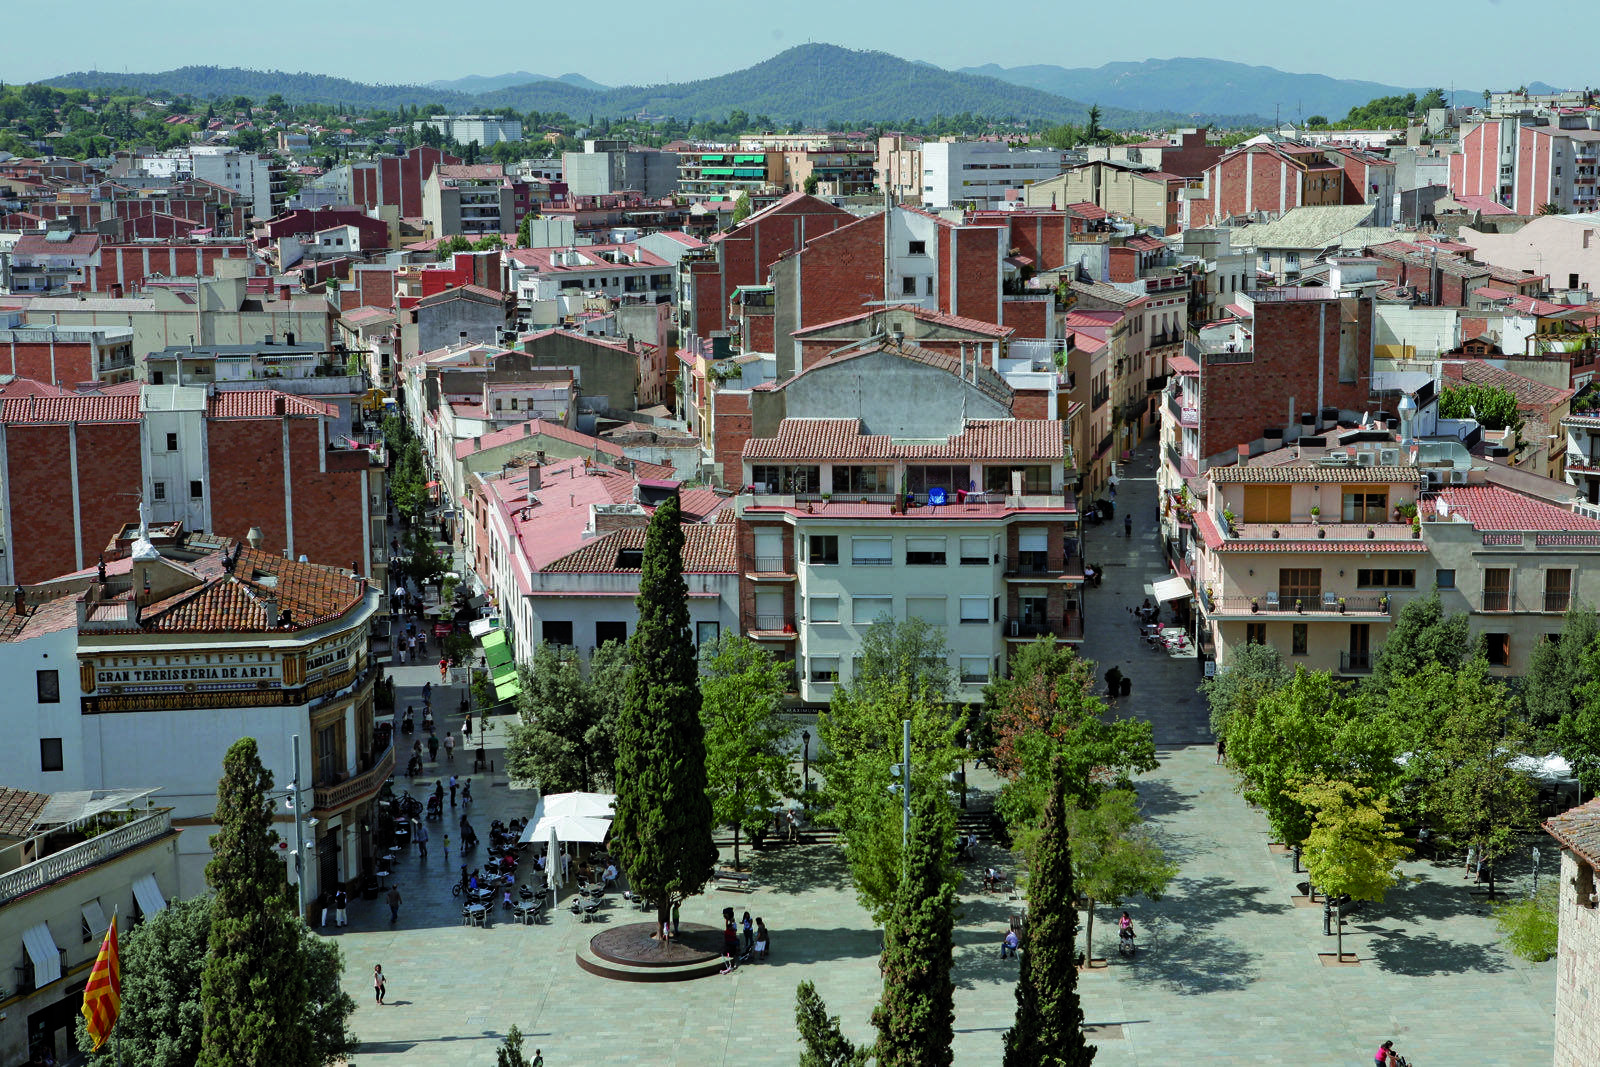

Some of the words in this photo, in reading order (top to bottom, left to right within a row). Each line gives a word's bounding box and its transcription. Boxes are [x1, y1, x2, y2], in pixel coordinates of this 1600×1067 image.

[307, 653, 334, 670] FABRICA
[336, 648, 346, 660] DE
[98, 671, 130, 683] GRAN
[134, 668, 218, 681] TERRISSERIA
[222, 667, 237, 678] DE
[241, 667, 273, 678] ARPI
